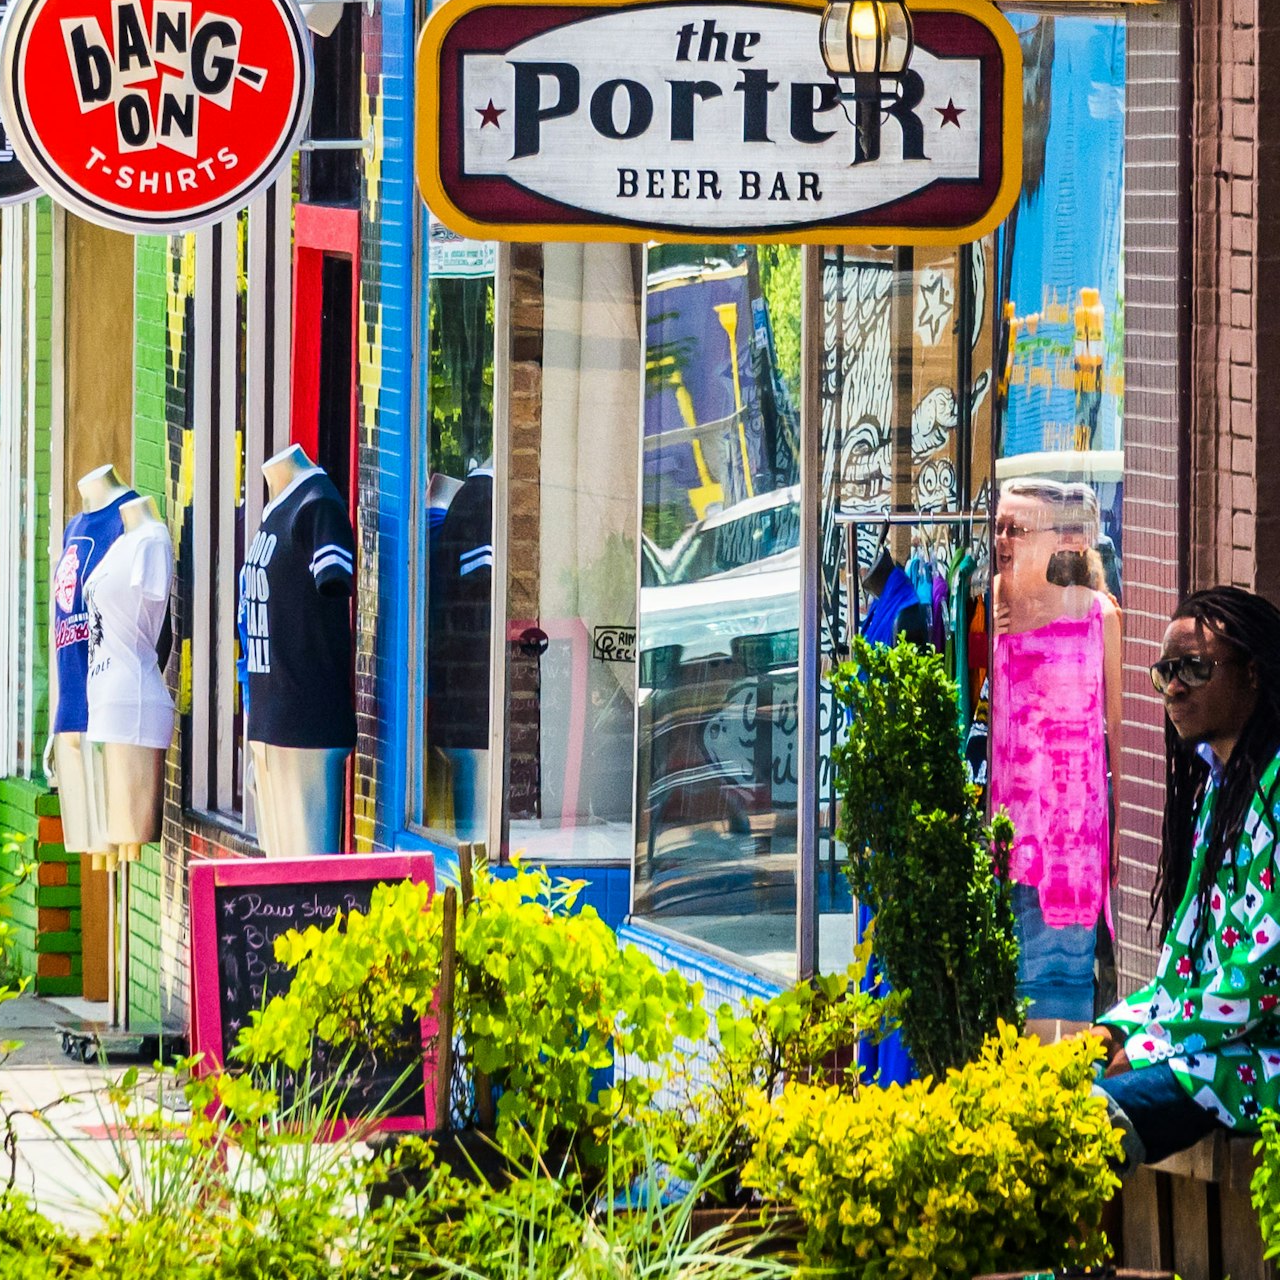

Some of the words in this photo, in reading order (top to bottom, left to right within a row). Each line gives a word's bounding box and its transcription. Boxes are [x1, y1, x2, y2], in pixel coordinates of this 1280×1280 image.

[675, 18, 762, 63] the
[119, 92, 196, 148] ON
[85, 146, 238, 195] T-SHIRTS
[616, 168, 722, 200] BEER
[739, 169, 823, 202] BAR
[239, 894, 294, 921] Raw
